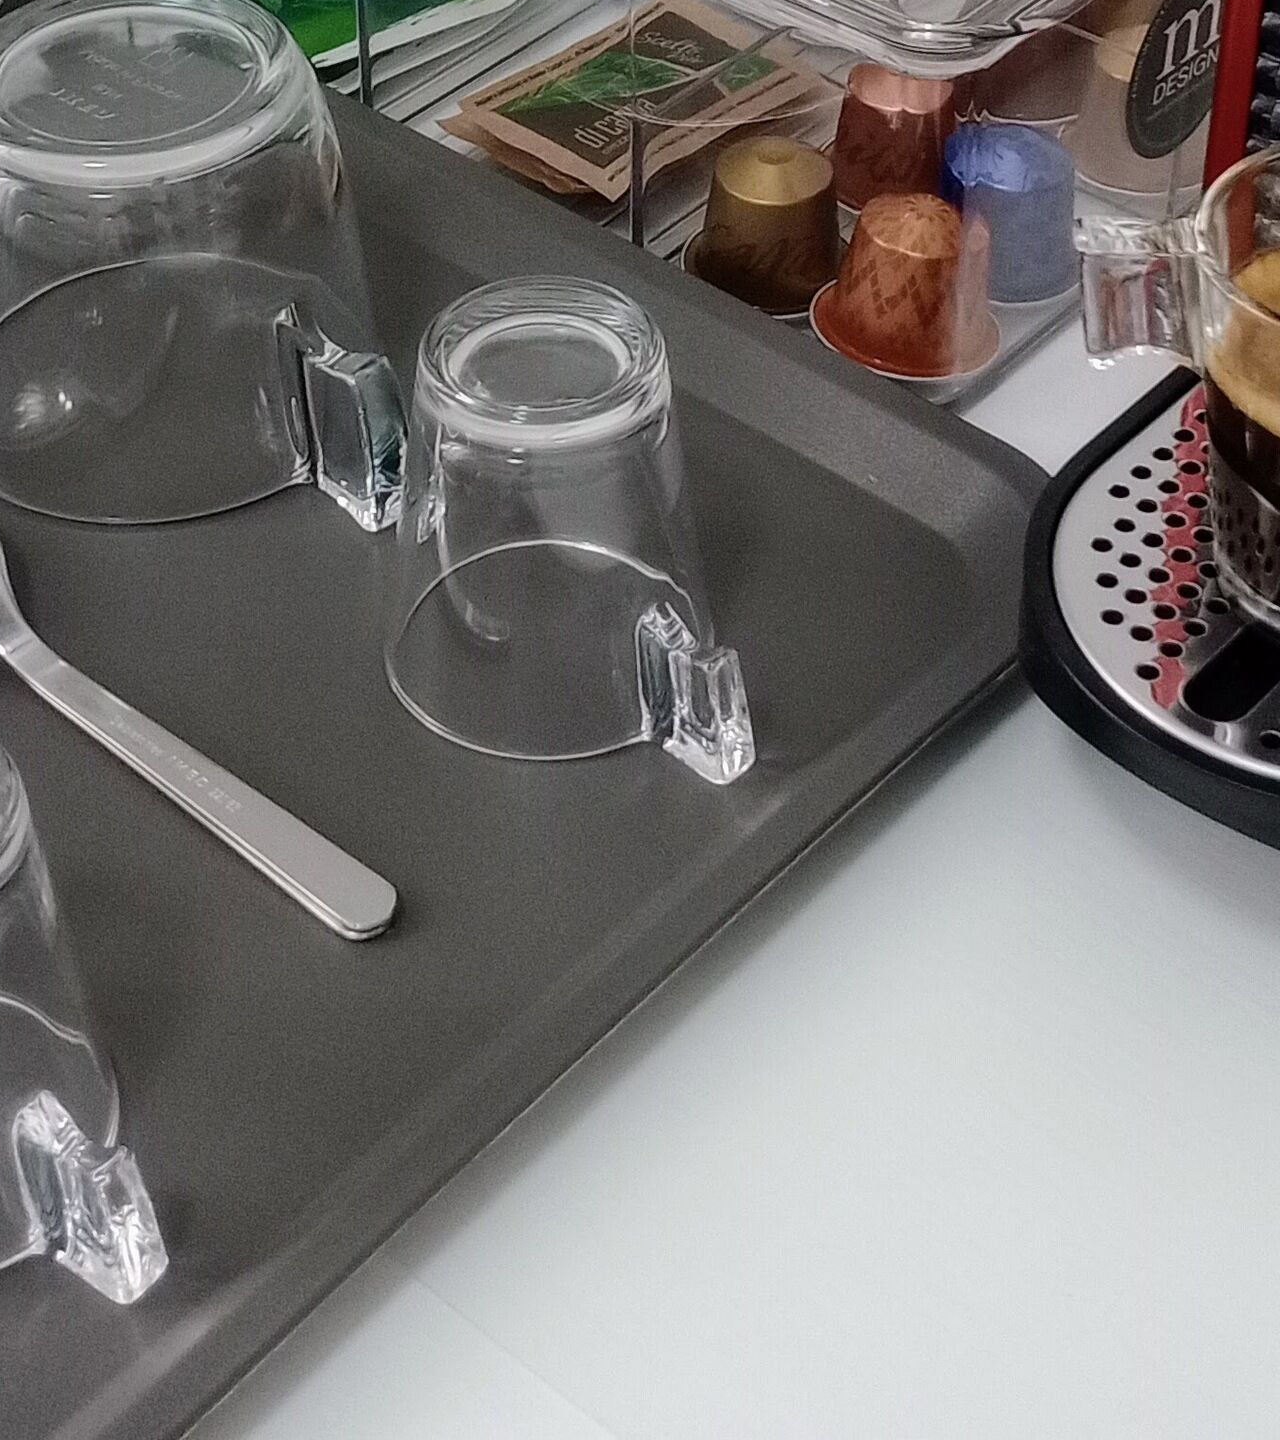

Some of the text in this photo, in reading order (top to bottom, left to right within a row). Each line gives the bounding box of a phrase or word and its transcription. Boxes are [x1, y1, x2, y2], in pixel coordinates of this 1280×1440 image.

[1152, 43, 1220, 106] DESIGN
[573, 124, 610, 148] di
[594, 98, 658, 136] caa
